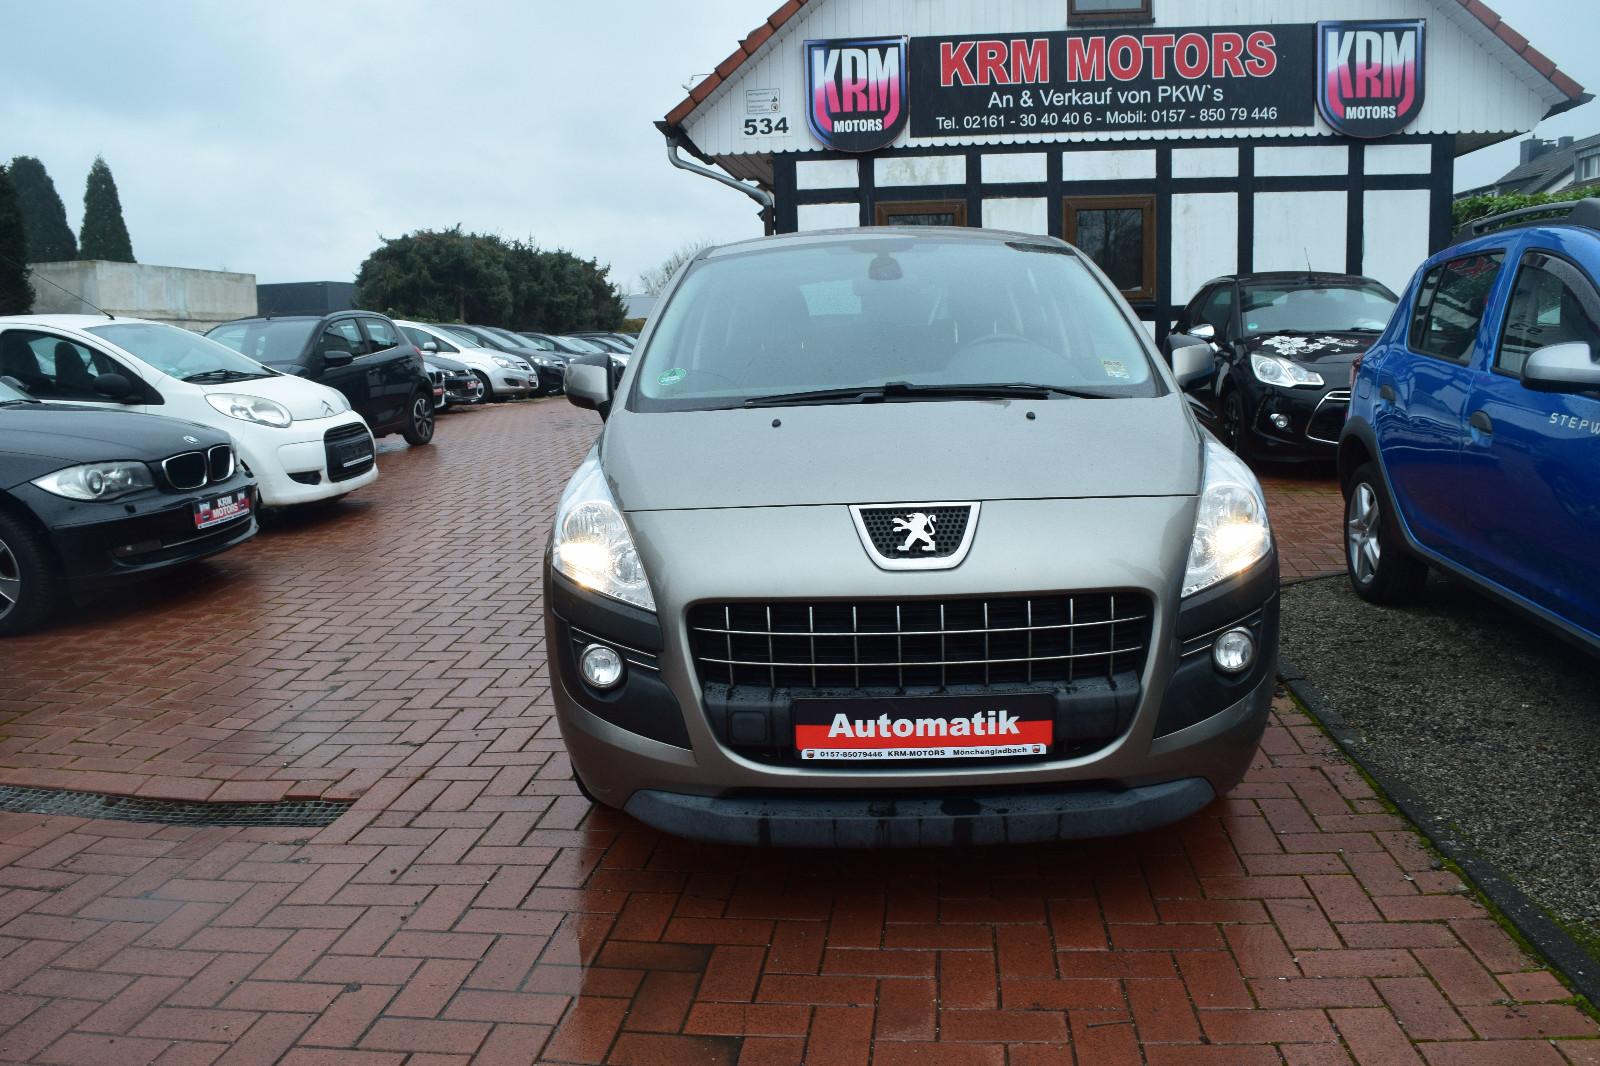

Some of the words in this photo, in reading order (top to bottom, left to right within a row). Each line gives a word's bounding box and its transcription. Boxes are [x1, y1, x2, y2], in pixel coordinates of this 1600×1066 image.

[940, 38, 1050, 87] KRM
[1067, 31, 1277, 82] MOTORS
[1328, 30, 1416, 99] KRM
[814, 47, 900, 113] KRM
[988, 91, 1013, 108] An
[1020, 89, 1034, 107] &
[1040, 87, 1113, 107] Verkauf
[1117, 90, 1151, 104] von
[936, 116, 959, 130] Tel.
[963, 115, 1005, 129] 02161
[1019, 113, 1037, 127] 30
[1041, 113, 1058, 126] 40
[1062, 112, 1079, 126] 40
[1083, 112, 1093, 125] 6
[1106, 110, 1147, 124] Mobil:
[1151, 109, 1186, 123] 0157
[1199, 108, 1226, 122] 850
[1229, 107, 1247, 121] 79
[1250, 106, 1278, 120] 446
[1345, 105, 1397, 120] MOTORS
[743, 116, 790, 136] 534
[833, 118, 883, 133] MOTORS
[827, 710, 1021, 738] Automatik
[953, 746, 1027, 756] Mönchengladbach
